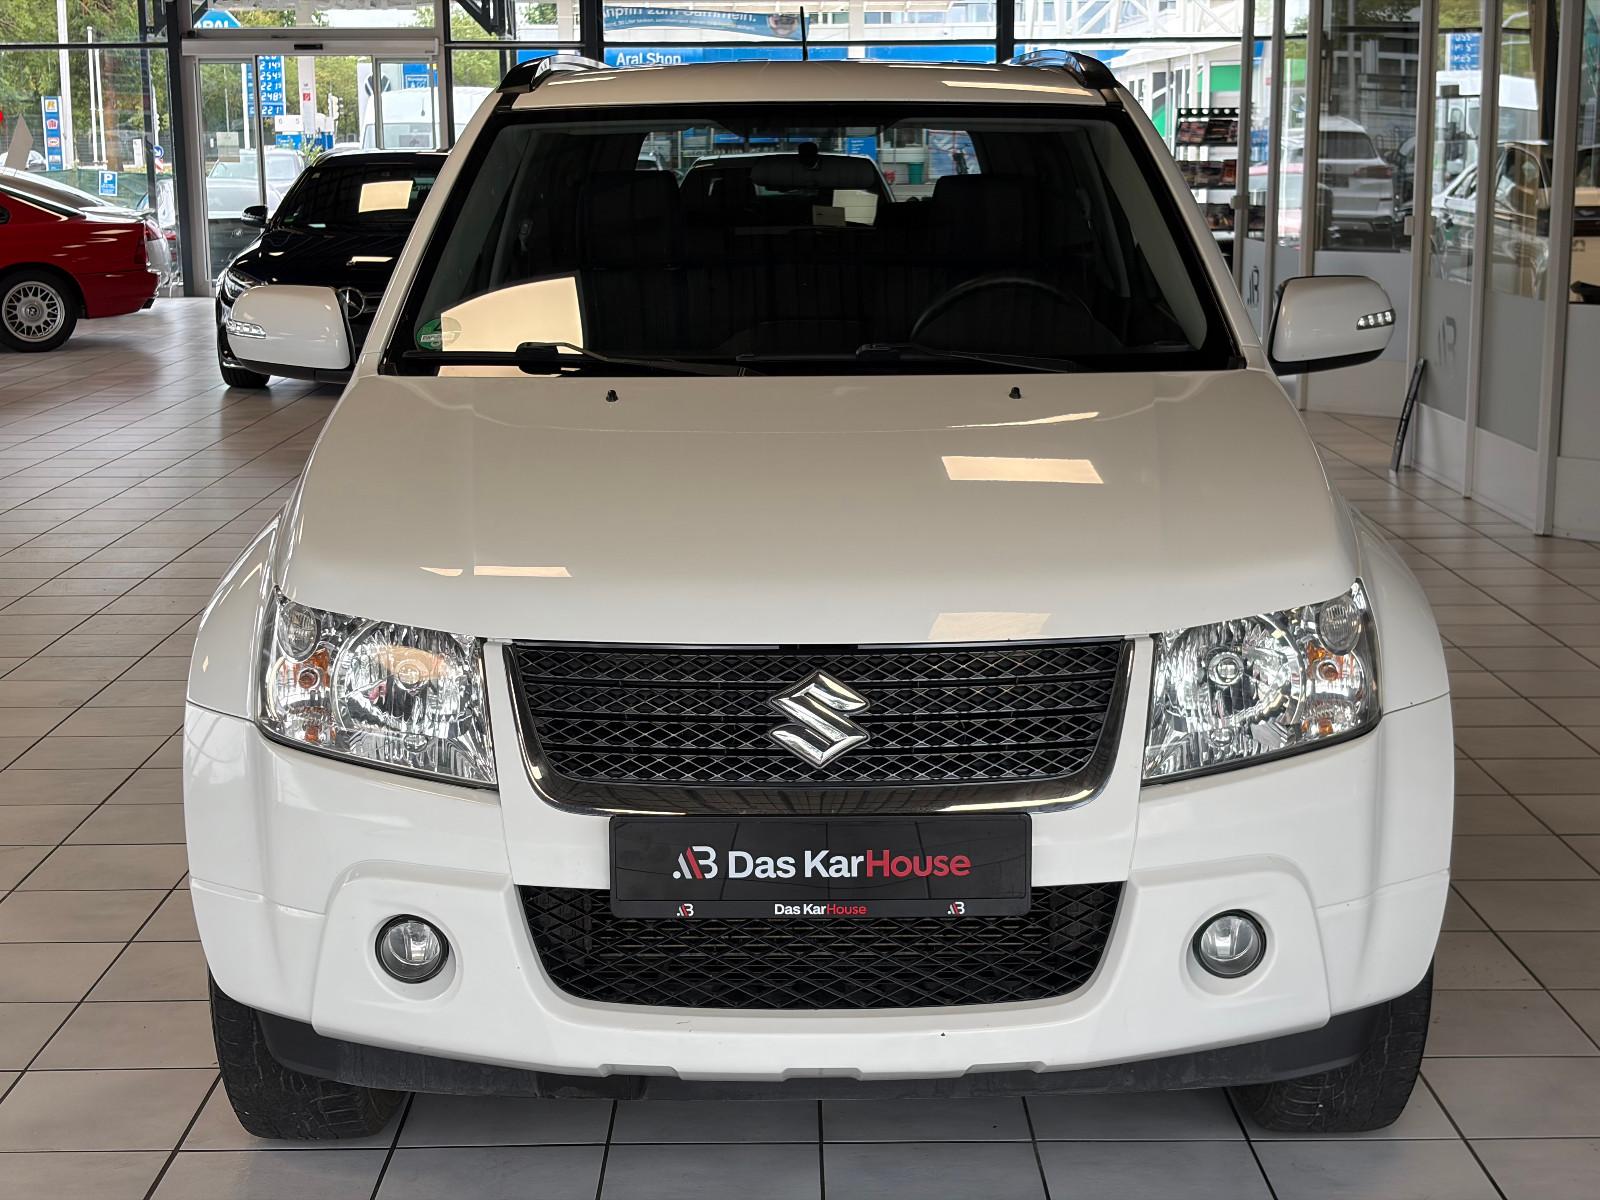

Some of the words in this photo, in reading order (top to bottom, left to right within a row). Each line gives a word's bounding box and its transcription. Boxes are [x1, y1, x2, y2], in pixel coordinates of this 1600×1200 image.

[615, 51, 644, 66] Aral
[103, 173, 114, 184] P
[728, 850, 796, 879] Das
[804, 849, 971, 879] KarHouse
[774, 903, 802, 916] Das
[803, 903, 867, 916] KarHouse
